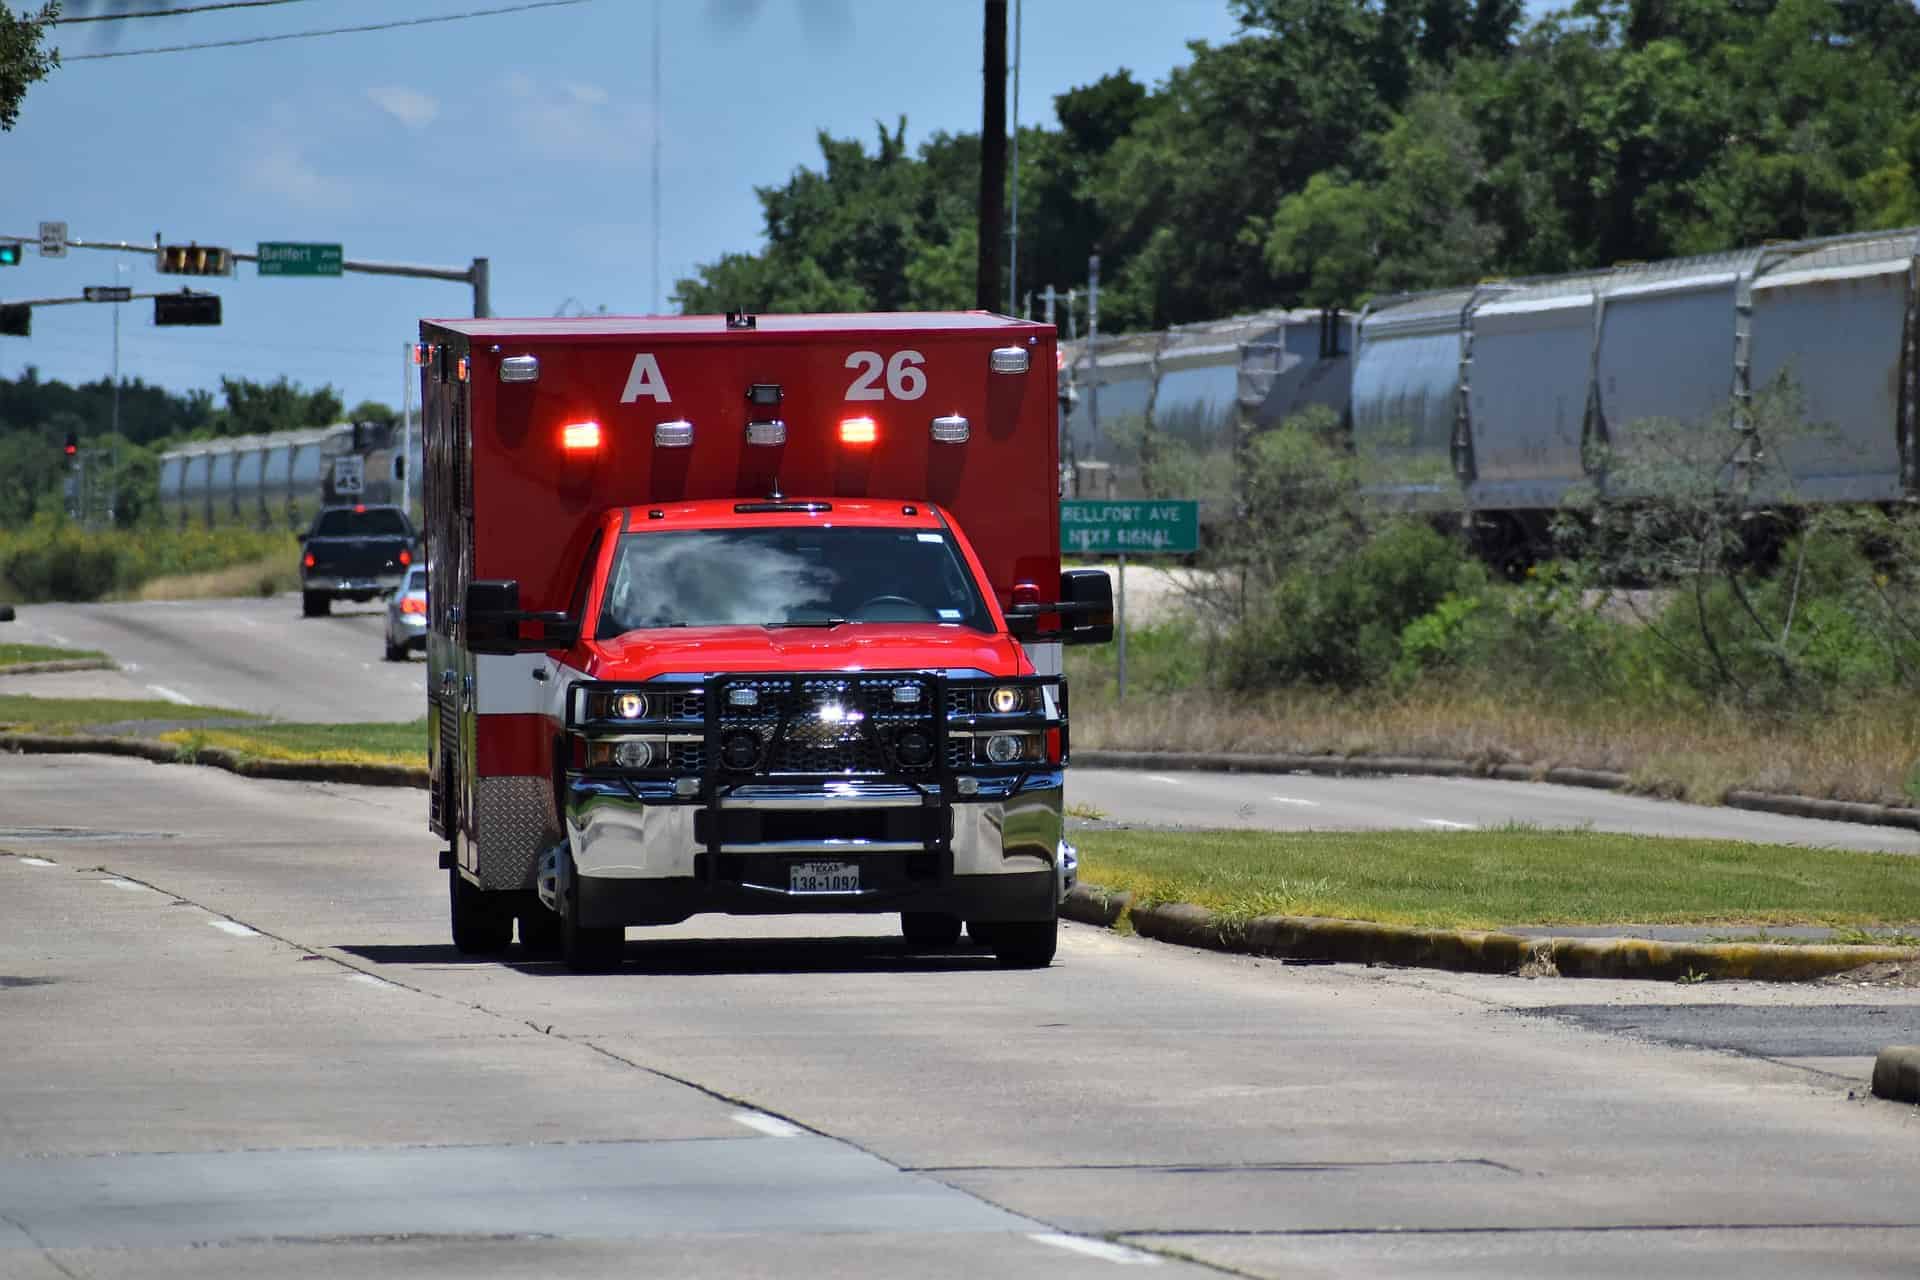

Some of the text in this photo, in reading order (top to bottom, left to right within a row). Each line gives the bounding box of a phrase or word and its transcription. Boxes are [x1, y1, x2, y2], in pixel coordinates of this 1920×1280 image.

[620, 353, 672, 403] A
[844, 350, 927, 401] 26
[337, 475, 361, 489] 45
[1062, 506, 1181, 521] BELLFORT AVE
[1069, 529, 1175, 546] NEXT SIGNAL
[811, 863, 840, 873] TEXAS
